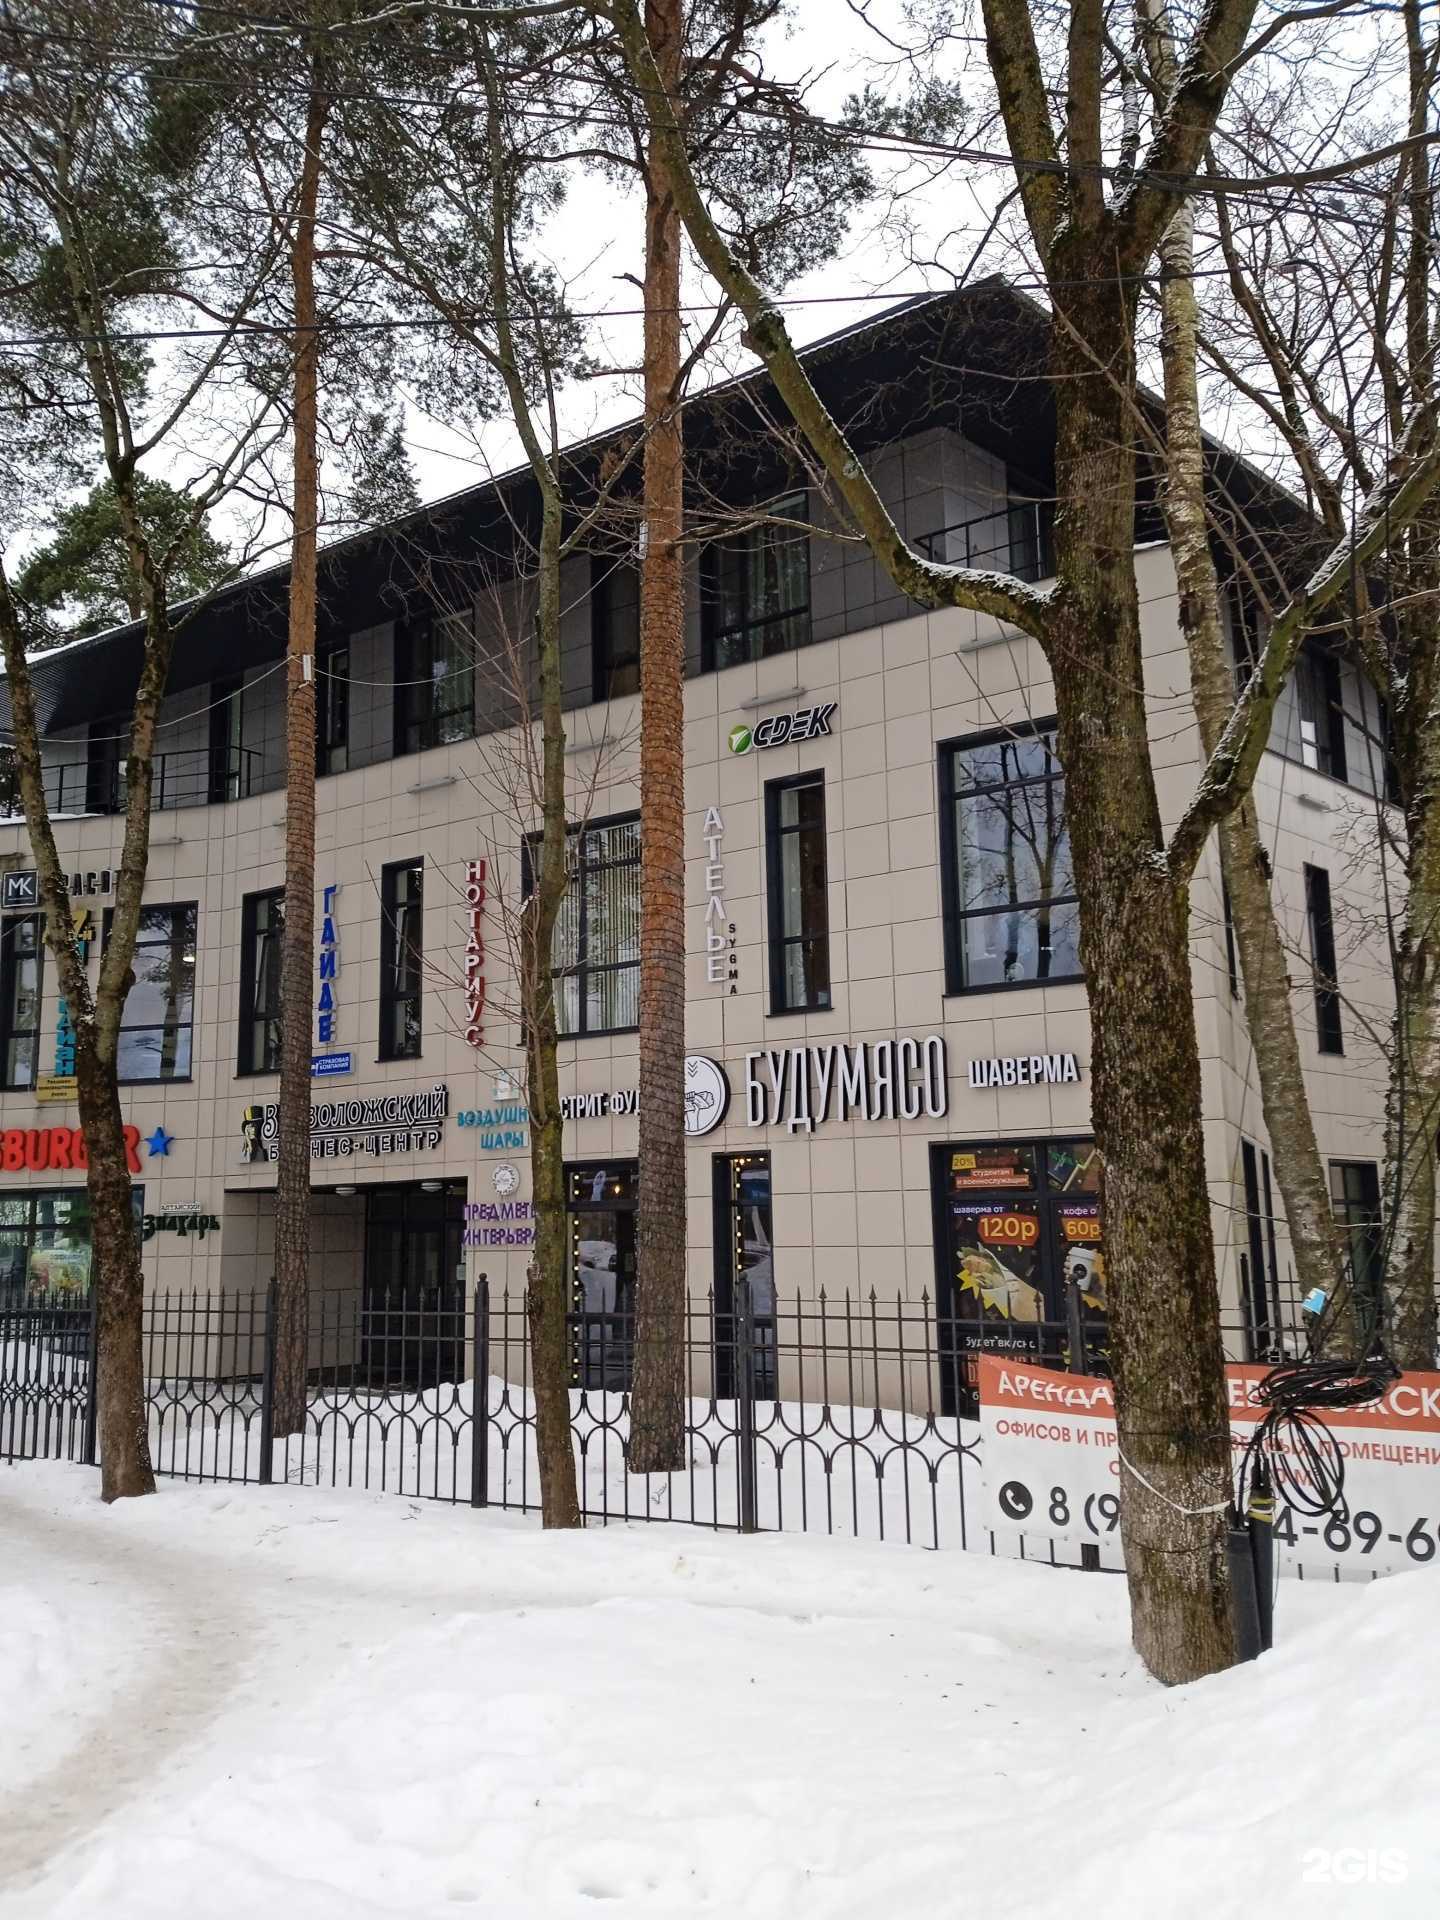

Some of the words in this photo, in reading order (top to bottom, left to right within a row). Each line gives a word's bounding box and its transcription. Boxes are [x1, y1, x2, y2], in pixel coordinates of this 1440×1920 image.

[752, 702, 837, 750] CDEK
[703, 806, 726, 983] АТЕЛЬЕ
[318, 883, 342, 1044] ГАЙДЕ
[464, 858, 486, 1048] НОТАРИУС
[728, 922, 737, 995] SYGMA
[745, 1034, 949, 1134] БУДУМЯСО
[968, 1052, 1080, 1089] ШАВЕРМА
[457, 1106, 529, 1128] ВОЗДУШН
[0, 1125, 142, 1173] BURGR
[268, 1131, 442, 1161] БНЕС-ЦЕНТР
[480, 1130, 525, 1150] ШАРЫ
[953, 1206, 992, 1215] шаверма
[993, 1205, 1005, 1213] от
[980, 1216, 1037, 1240] 120р
[998, 1370, 1115, 1409] АРЕНДА
[996, 1419, 1072, 1443] ОФИСОВ
[1077, 1430, 1088, 1445] И
[1050, 1486, 1070, 1526] 8
